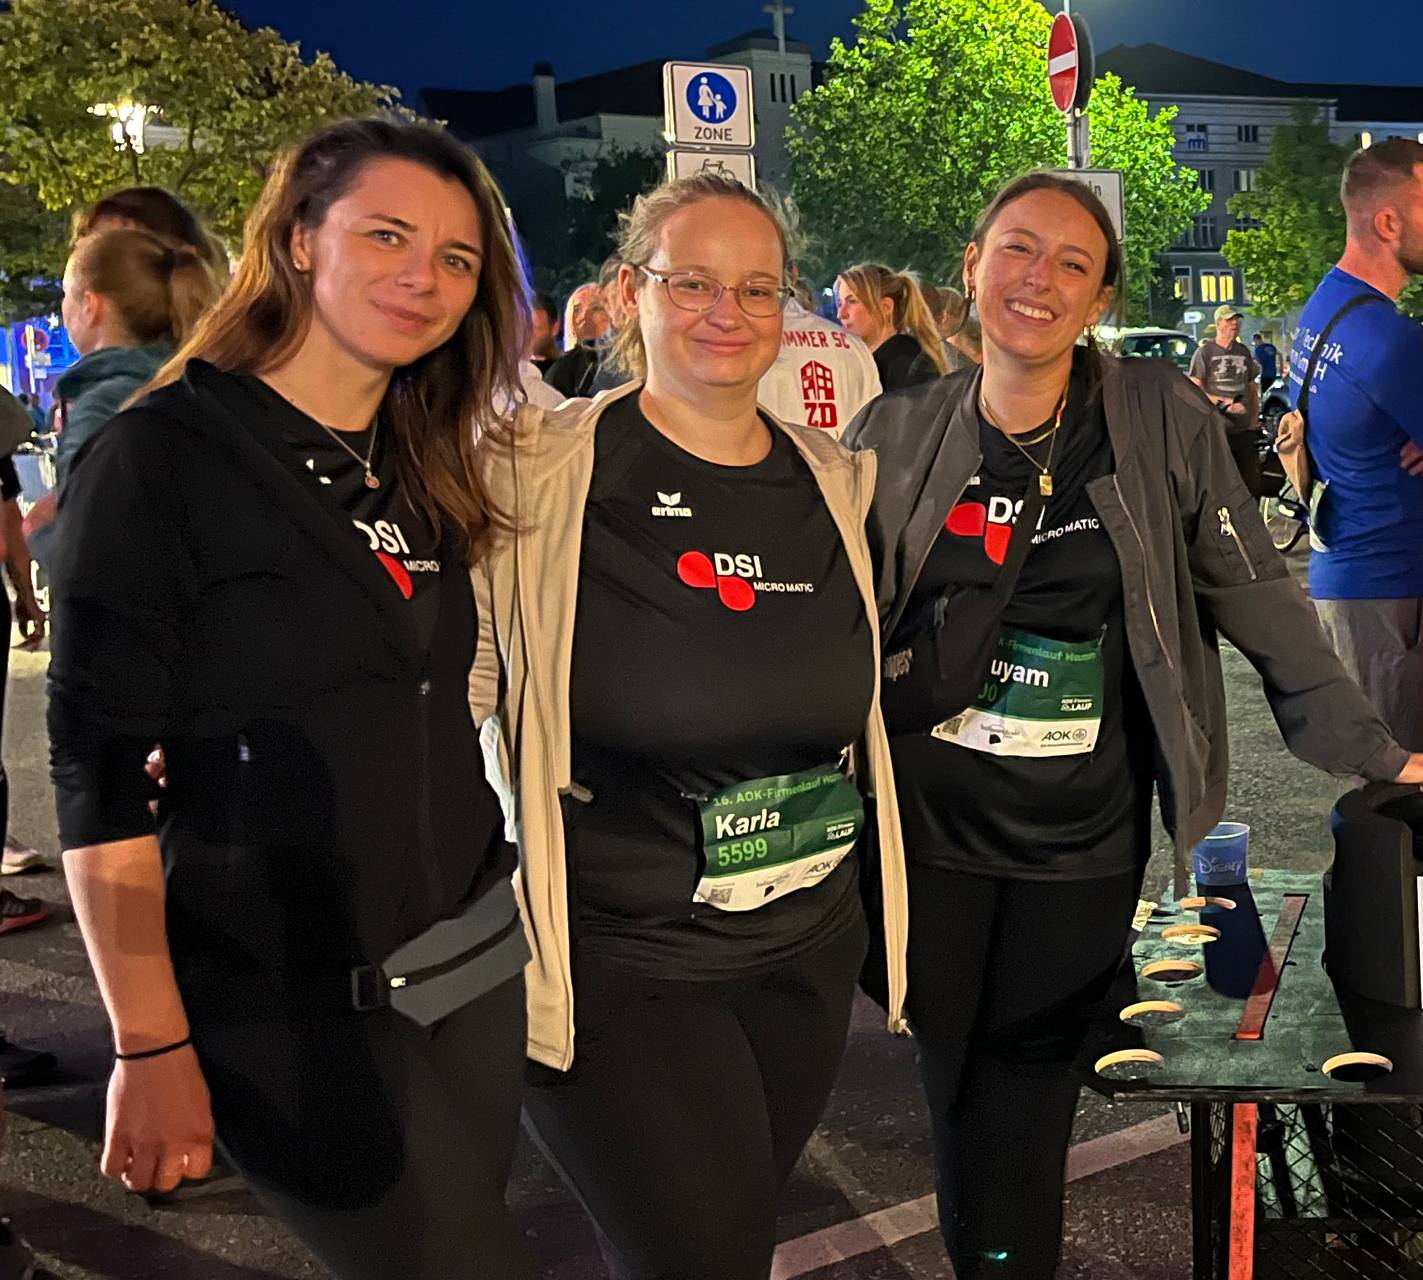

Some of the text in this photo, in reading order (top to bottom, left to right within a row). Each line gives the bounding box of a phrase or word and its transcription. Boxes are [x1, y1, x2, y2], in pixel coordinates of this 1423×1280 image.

[694, 126, 733, 141] ZONE
[831, 331, 850, 349] SC
[804, 403, 838, 428] ZD
[1064, 518, 1100, 533] MATIC
[403, 560, 440, 573] MICRO
[714, 553, 763, 578] DSI
[753, 581, 814, 593] MICRO MATIC
[990, 659, 1050, 688] uyam
[1041, 730, 1071, 742] AOK
[714, 797, 733, 807] 16.
[735, 779, 821, 804] AOK-Firmenlauf
[715, 808, 781, 839] Karla
[717, 837, 768, 867] 5599
